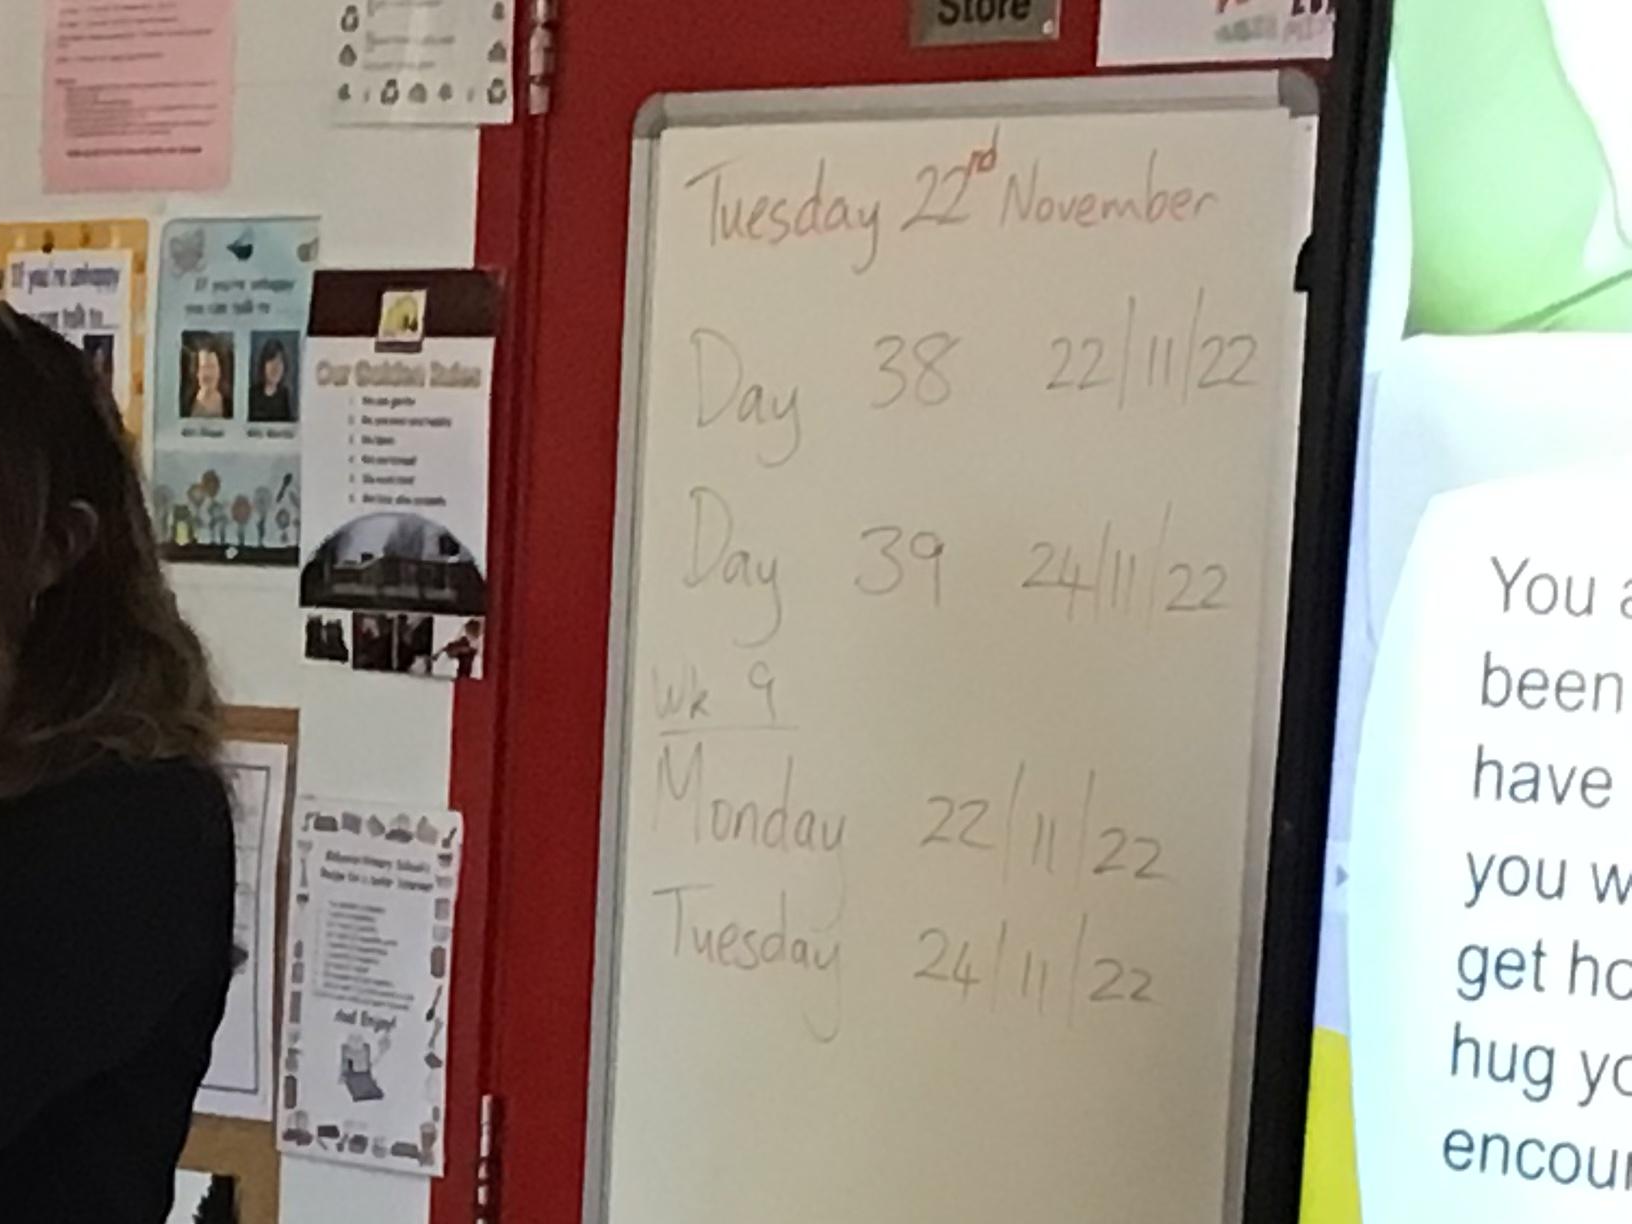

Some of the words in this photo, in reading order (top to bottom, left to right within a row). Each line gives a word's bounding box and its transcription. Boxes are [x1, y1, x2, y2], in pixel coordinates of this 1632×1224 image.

[937, 0, 1031, 26] Store
[684, 159, 881, 276] Tuesday
[999, 149, 1218, 229] November
[689, 327, 802, 468] Day
[868, 332, 961, 407] 38
[1045, 287, 1258, 411] 22/11/22
[682, 486, 782, 648] Day
[854, 525, 944, 607] 39
[1022, 500, 1227, 630] 24/11/22
[1491, 555, 1596, 618] You
[749, 660, 776, 721] 9
[1481, 650, 1623, 714] been
[1472, 744, 1612, 809] have
[920, 762, 1169, 886] 22/11/22
[1465, 850, 1566, 909] you
[652, 884, 842, 1043] Tuesday
[913, 913, 1155, 1022] 24/11/22
[1457, 938, 1546, 1001] get
[1450, 1021, 1556, 1102] hug
